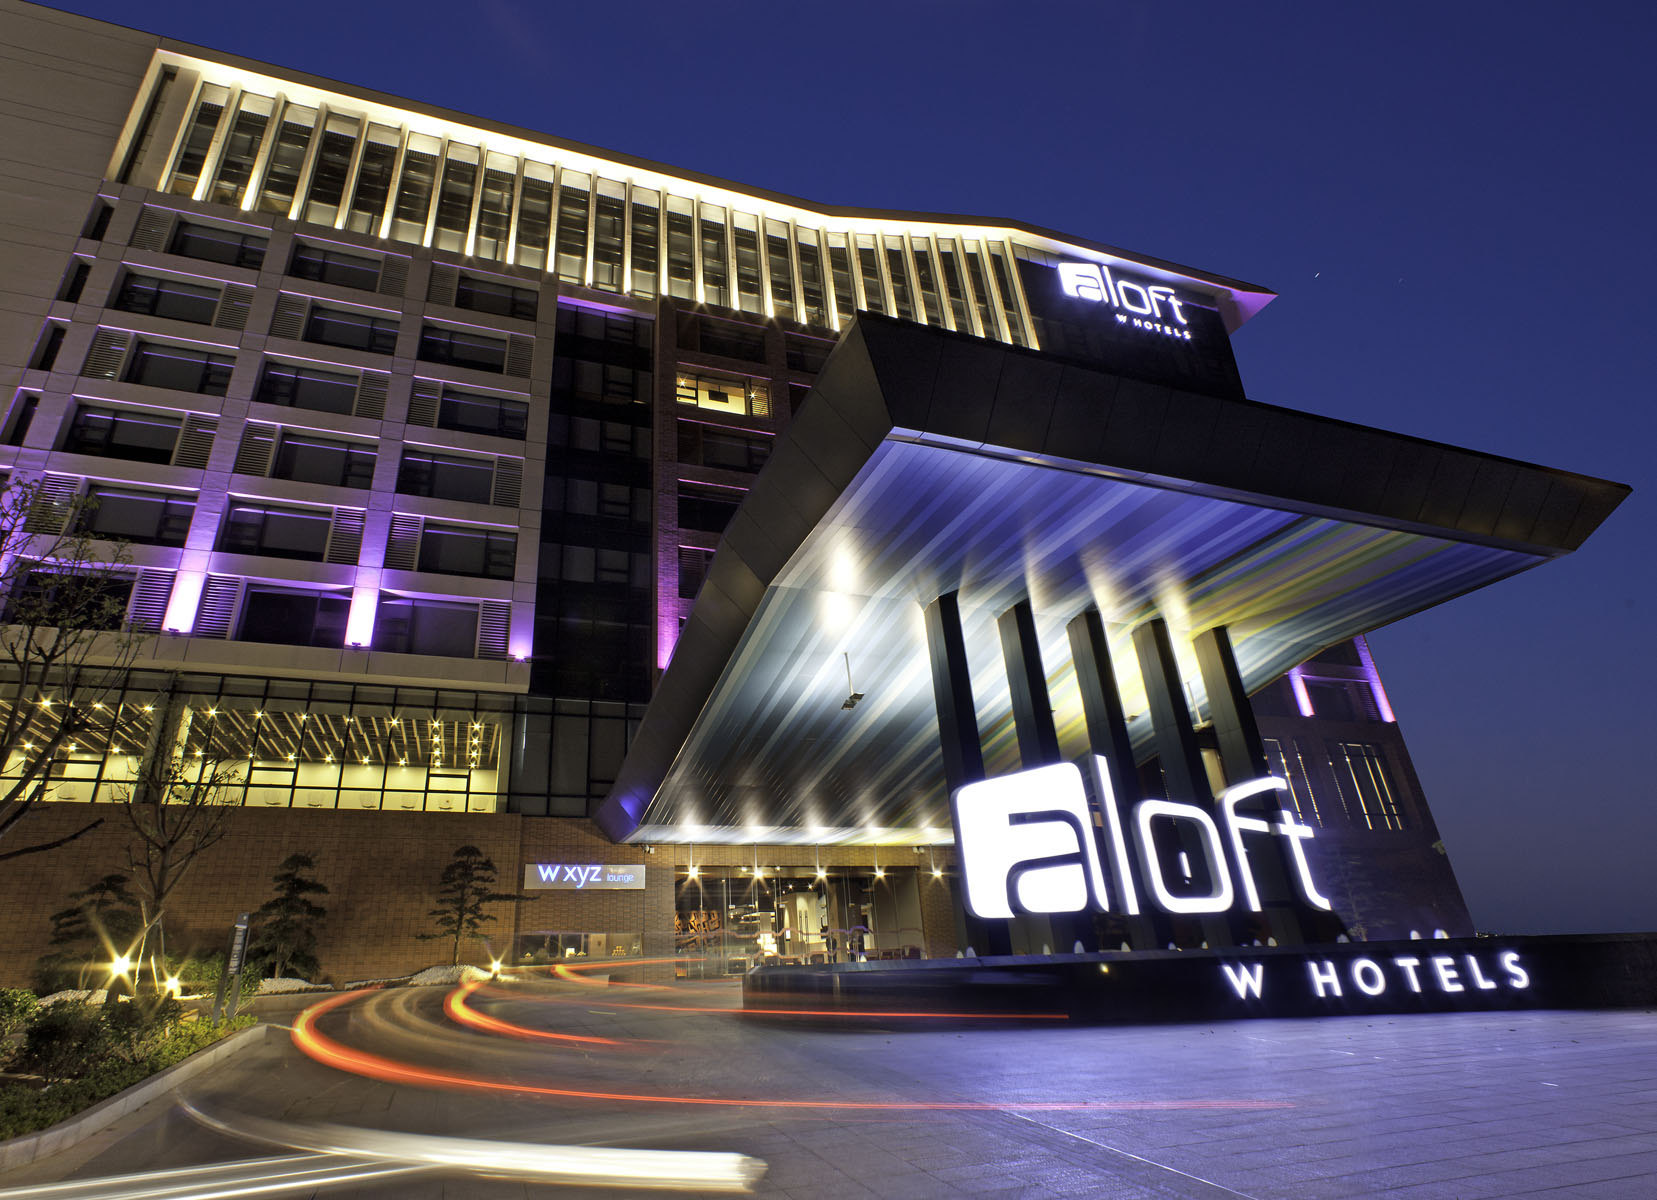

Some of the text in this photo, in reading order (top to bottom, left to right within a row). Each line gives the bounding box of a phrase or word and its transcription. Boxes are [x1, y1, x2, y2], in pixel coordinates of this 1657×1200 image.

[1058, 262, 1187, 324] aloft
[1116, 313, 1191, 340] W HOTELS
[951, 754, 1332, 919] aloft
[563, 866, 602, 888] xyz
[606, 873, 634, 884] lounge
[1222, 951, 1530, 1000] W HOTELS
